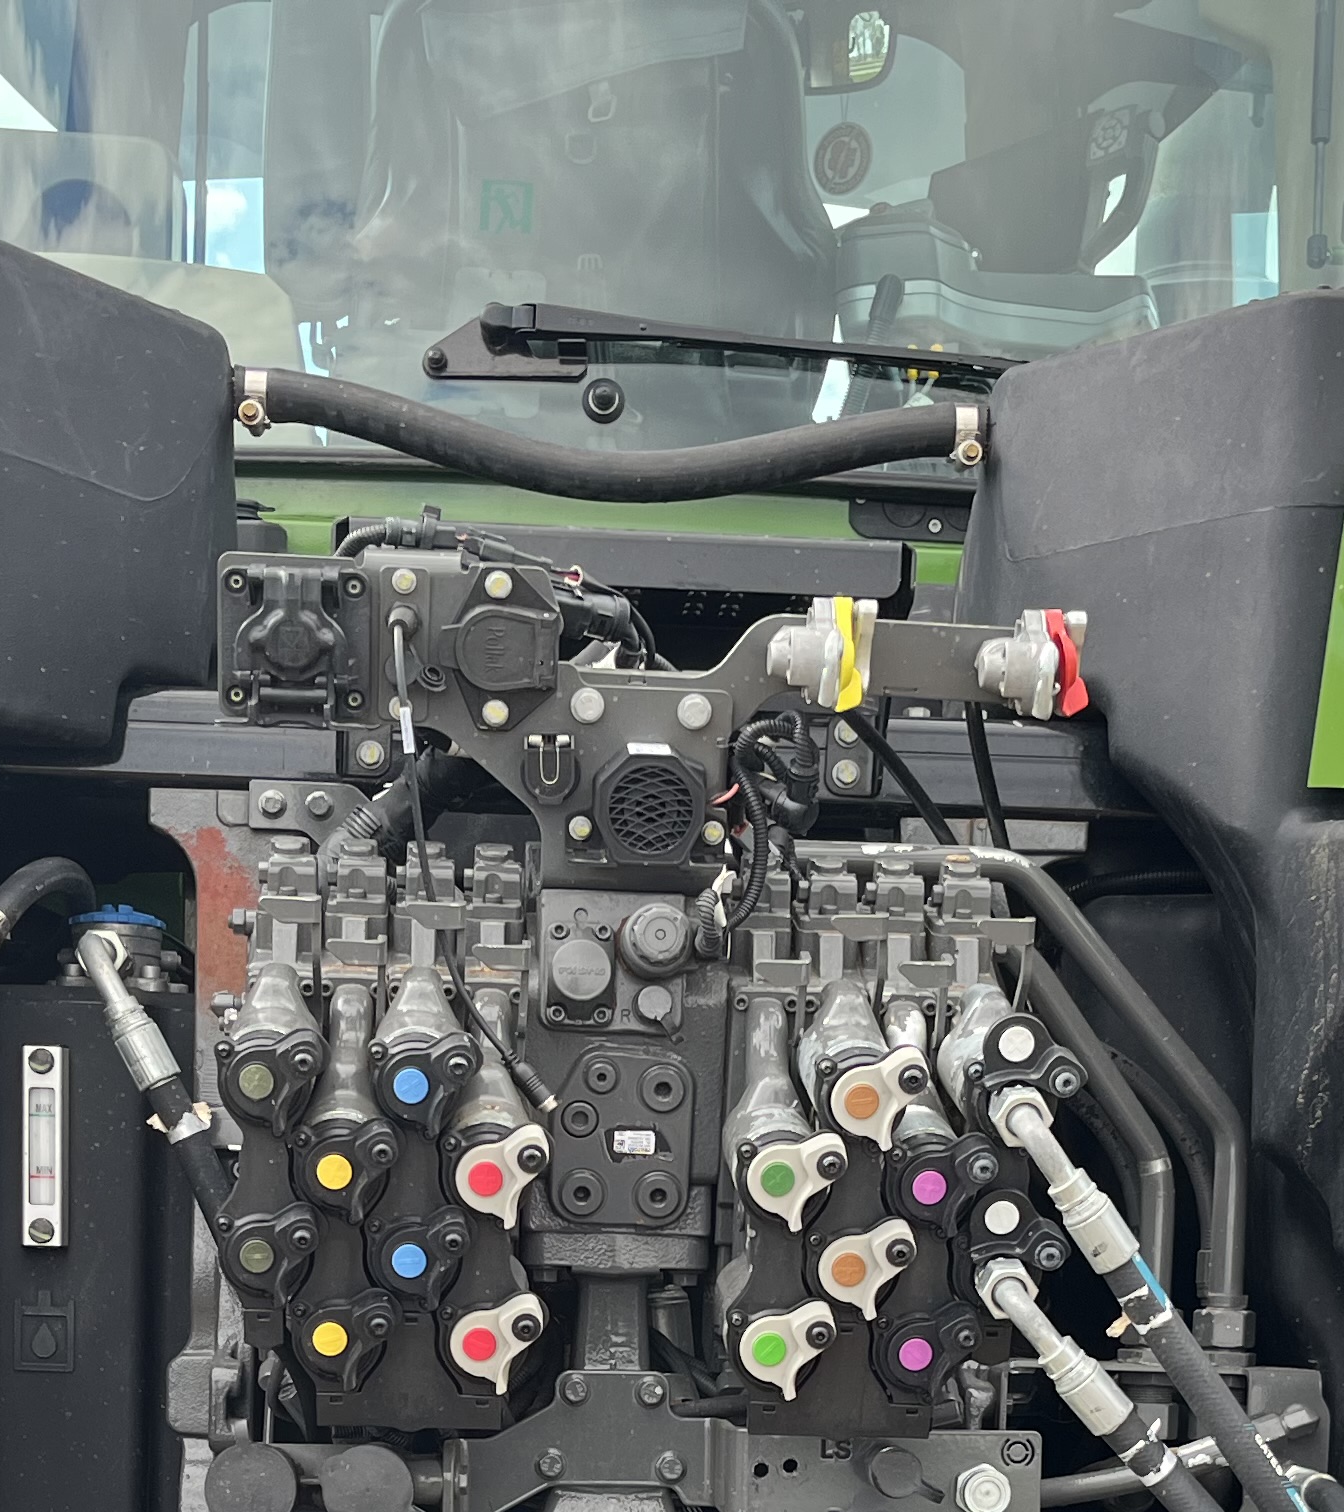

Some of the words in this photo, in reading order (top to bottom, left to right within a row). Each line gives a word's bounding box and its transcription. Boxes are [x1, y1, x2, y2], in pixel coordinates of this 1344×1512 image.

[35, 1103, 52, 1113] MAX
[36, 1165, 53, 1175] MIN
[820, 1438, 852, 1460] LS
